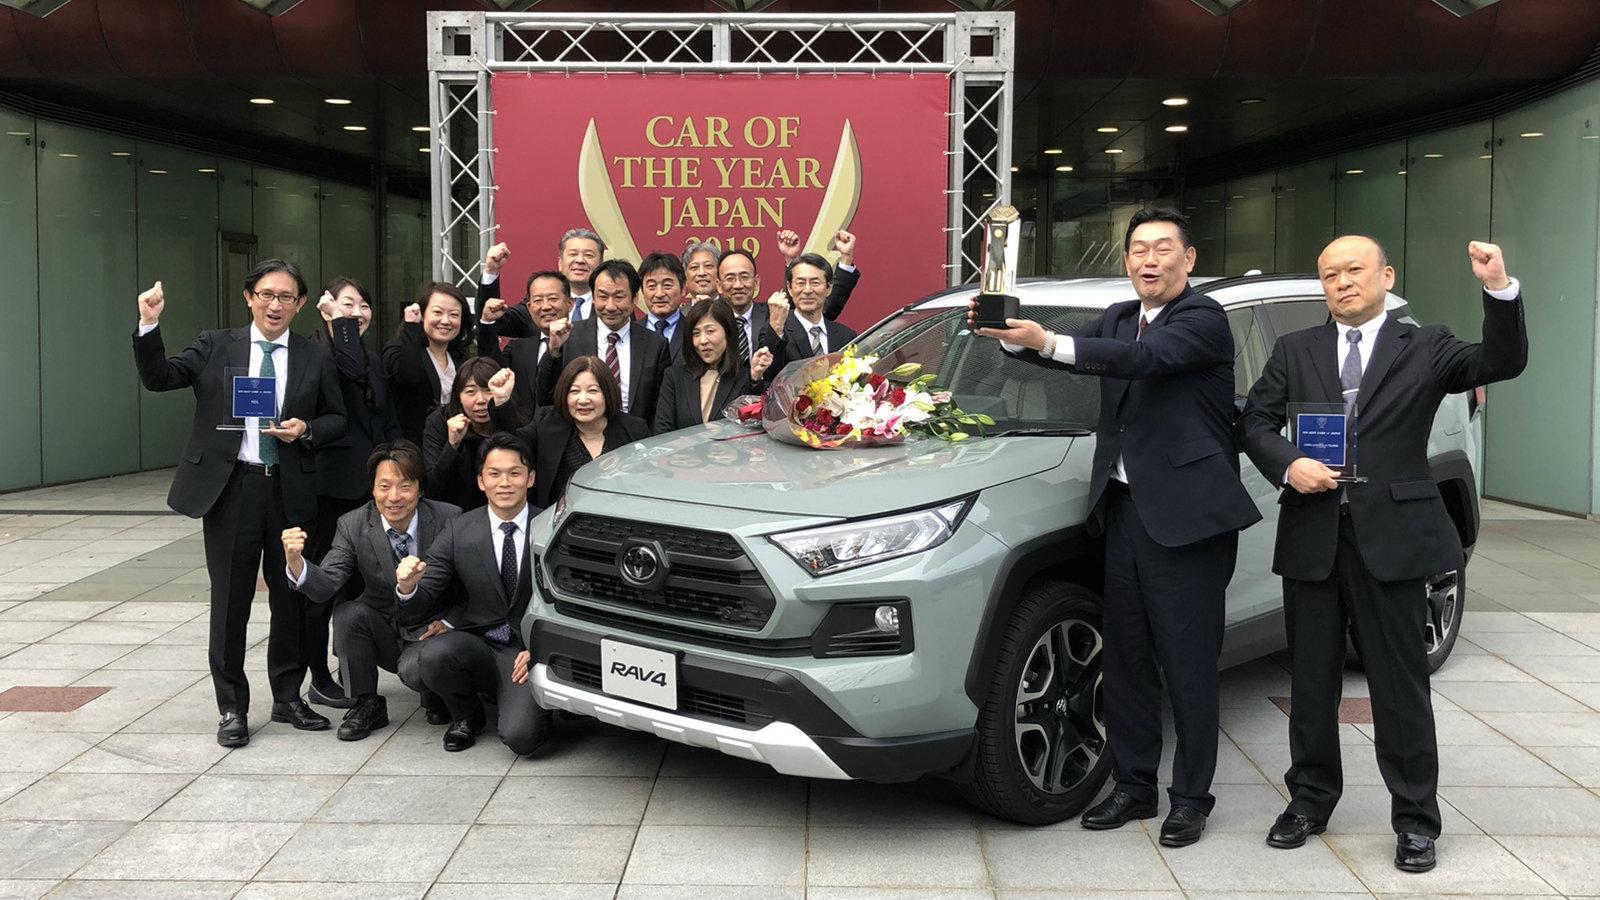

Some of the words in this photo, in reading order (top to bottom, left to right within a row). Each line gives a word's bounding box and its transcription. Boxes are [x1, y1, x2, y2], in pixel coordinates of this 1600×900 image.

[645, 116, 733, 148] CAR
[743, 116, 801, 148] OF
[614, 157, 703, 189] THE
[712, 157, 824, 189] YEAR
[657, 197, 786, 237] JAPAN
[685, 236, 761, 259] 19
[610, 661, 667, 687] RAV4
